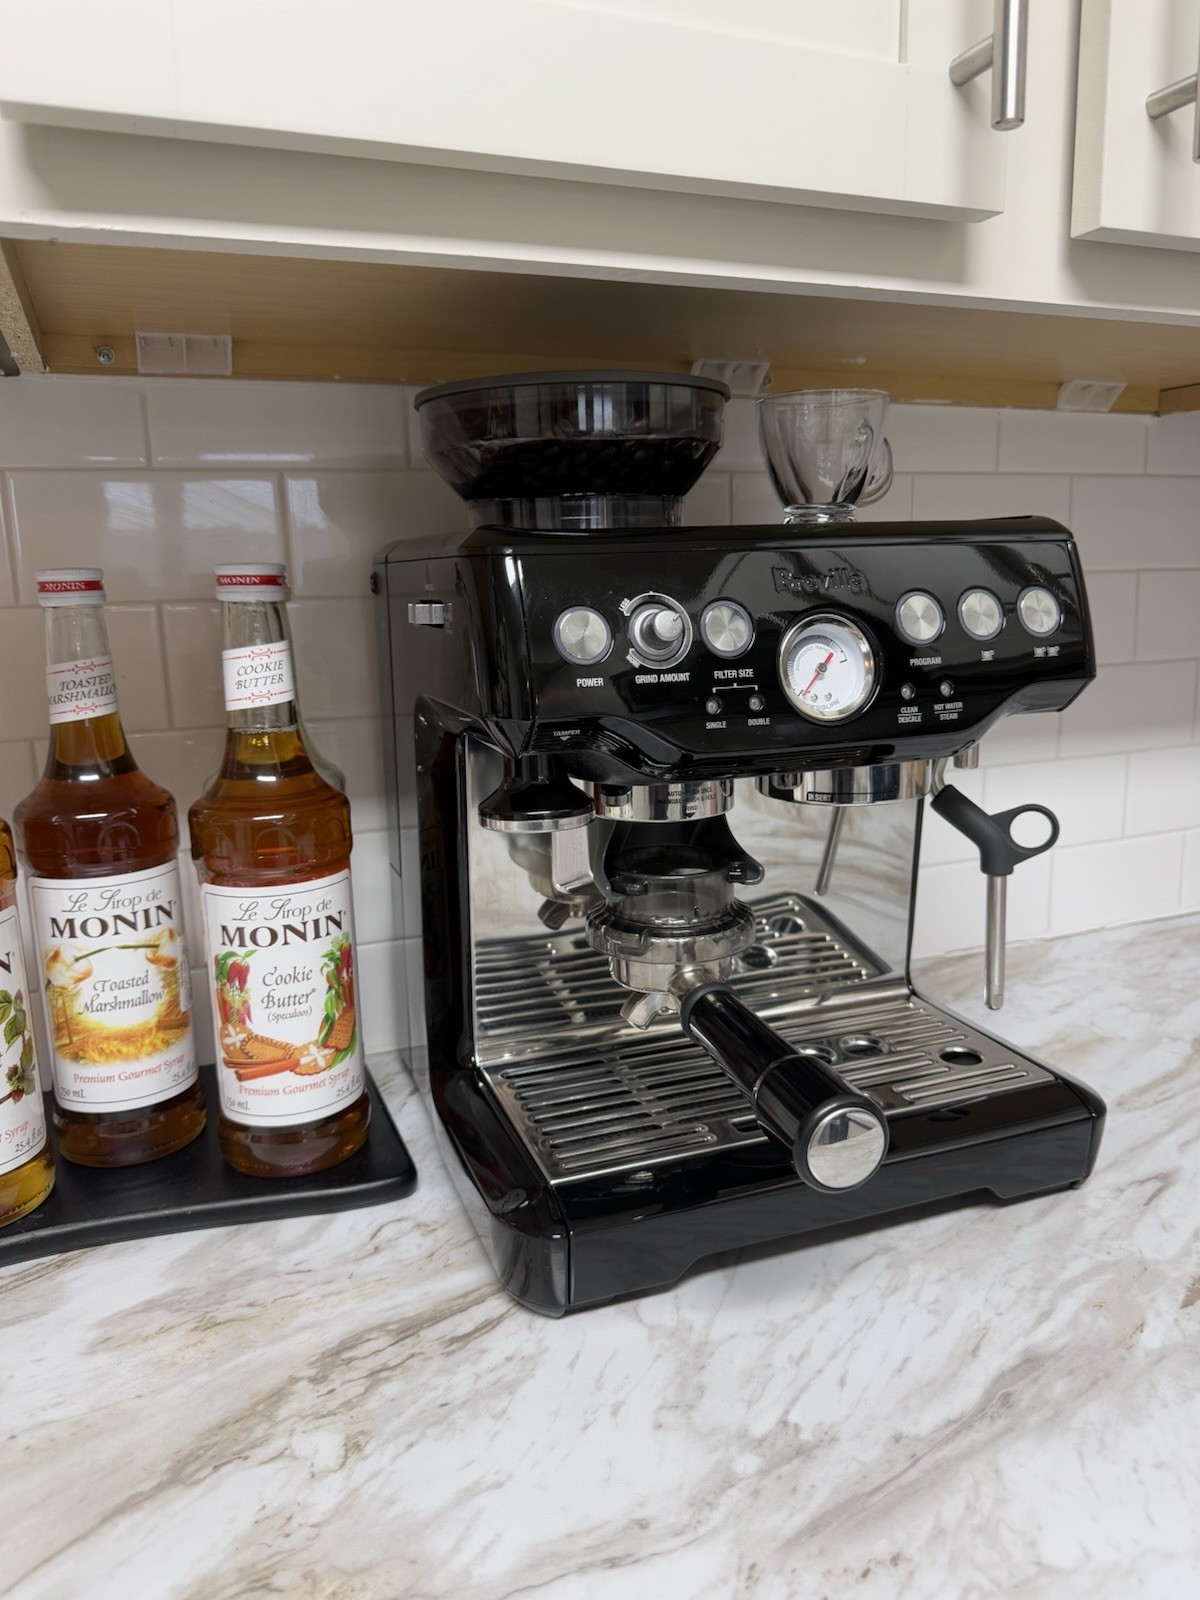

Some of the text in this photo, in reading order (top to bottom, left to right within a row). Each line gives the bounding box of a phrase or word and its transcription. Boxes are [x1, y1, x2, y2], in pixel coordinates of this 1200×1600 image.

[237, 660, 284, 676] COOKIE
[909, 656, 942, 666] PROGRAM
[60, 673, 111, 692] TOASTED
[235, 673, 284, 690] BUTTER
[576, 678, 604, 687] POWER
[635, 672, 690, 684] GRIND AMOUNT
[714, 669, 754, 679] FILTER SIZE
[900, 706, 918, 714] CLEAN
[940, 713, 958, 721] STEAM
[705, 721, 727, 729] SINGLE
[747, 718, 770, 726] DOUBLE
[62, 889, 162, 912] Le Sirop de
[232, 899, 332, 921] Le Sirop de
[49, 900, 173, 938] MONIN
[220, 910, 343, 948] MONIN
[93, 970, 149, 992] Toasted
[262, 966, 313, 987] Cookie
[78, 990, 164, 1015] Marshmallow
[73, 1073, 115, 1084] Premium
[118, 1061, 162, 1081] Gourmet
[72, 1089, 86, 1098] mL
[239, 1084, 279, 1096] Premium
[283, 1079, 326, 1095] Gourmet
[5, 1121, 29, 1144] Syrup
